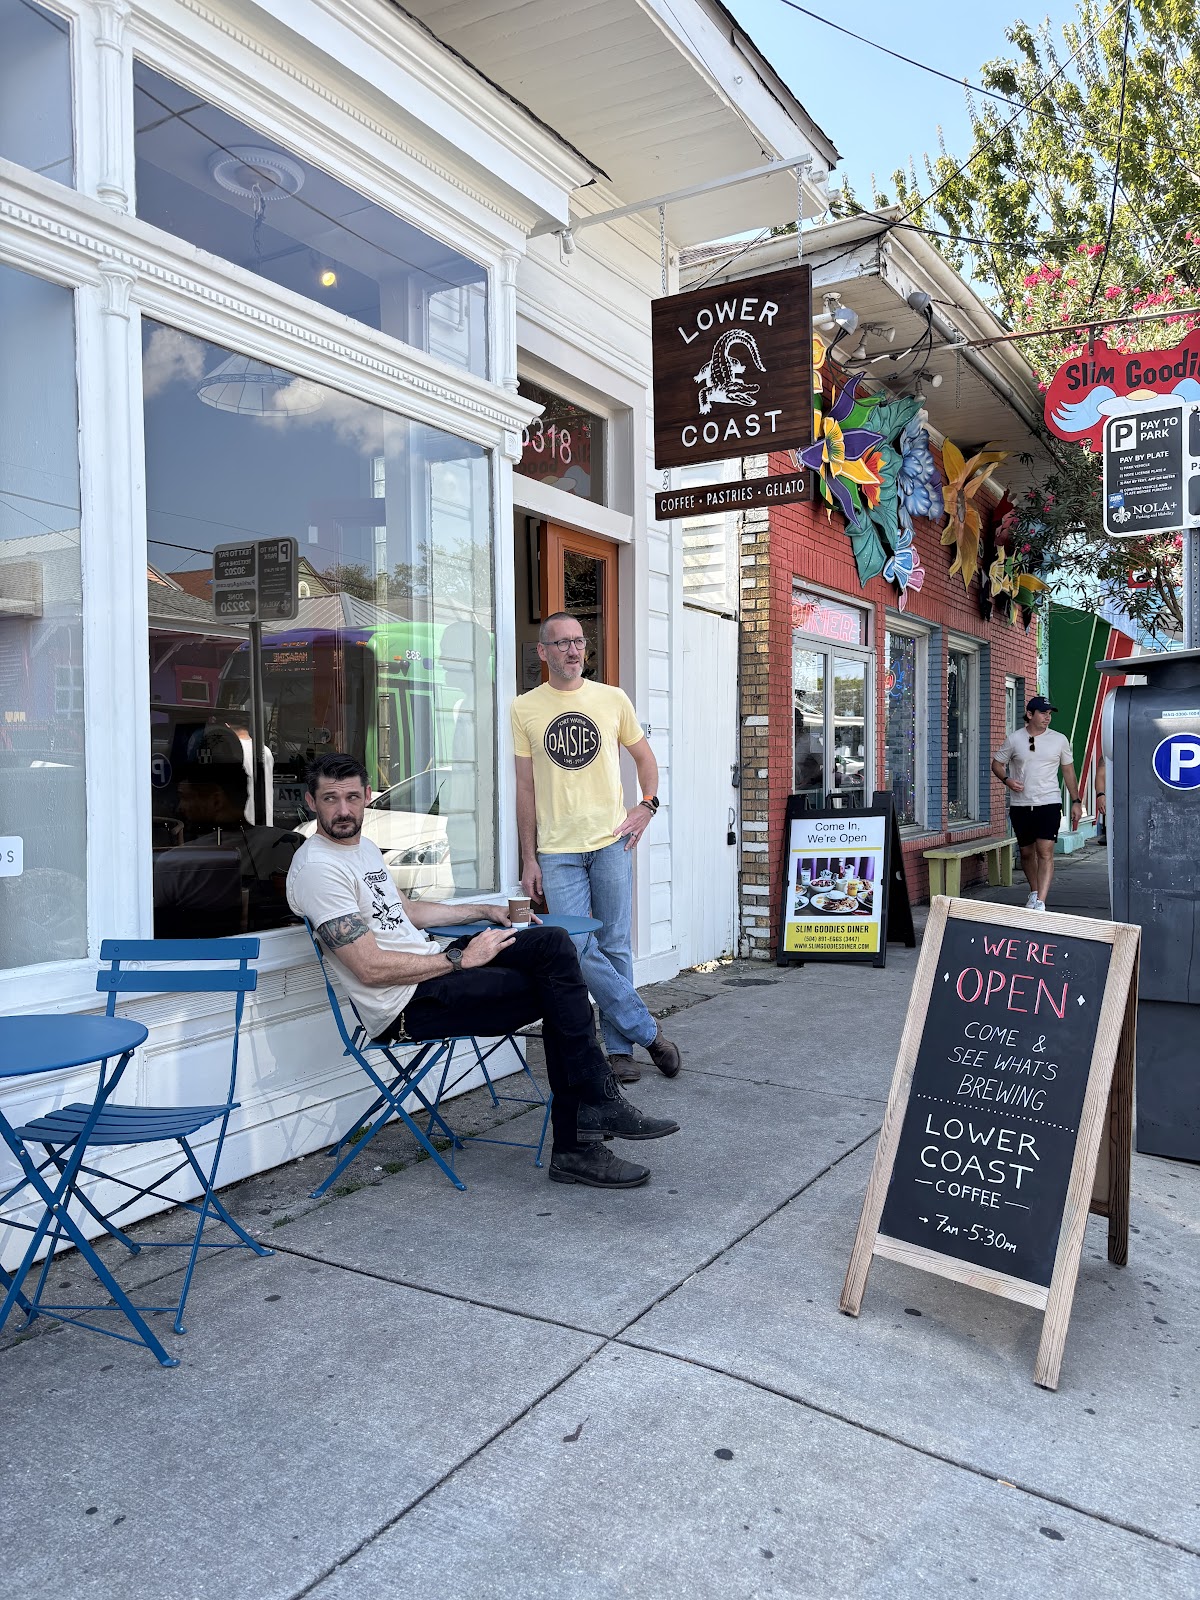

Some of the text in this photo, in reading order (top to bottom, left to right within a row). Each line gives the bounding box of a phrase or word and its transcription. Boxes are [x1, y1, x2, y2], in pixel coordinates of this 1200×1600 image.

[678, 298, 779, 344] LOWER
[1126, 348, 1200, 388] Goodi
[682, 410, 782, 448] COAST
[1115, 424, 1132, 448] P
[1140, 417, 1178, 430] PAY TO
[1140, 429, 1170, 441] PARK
[1146, 451, 1169, 460] PLATE
[660, 478, 804, 512] COFFEE PASTRIES GELATO
[1133, 502, 1177, 514] NOLA+
[548, 726, 596, 756] DAISIES
[1170, 742, 1200, 781] P
[808, 833, 867, 844] We're Open
[815, 822, 860, 832] Come In,
[984, 936, 1058, 966] WE'RE
[956, 967, 1068, 1019] OPEN
[964, 1022, 1046, 1053] COME &
[948, 1046, 1058, 1081] SEE WHAT'S
[957, 1074, 1047, 1111] BREWING
[925, 1114, 1040, 1161] LOWER
[921, 1146, 1034, 1189] COAST
[936, 1180, 1001, 1209] COFFEE
